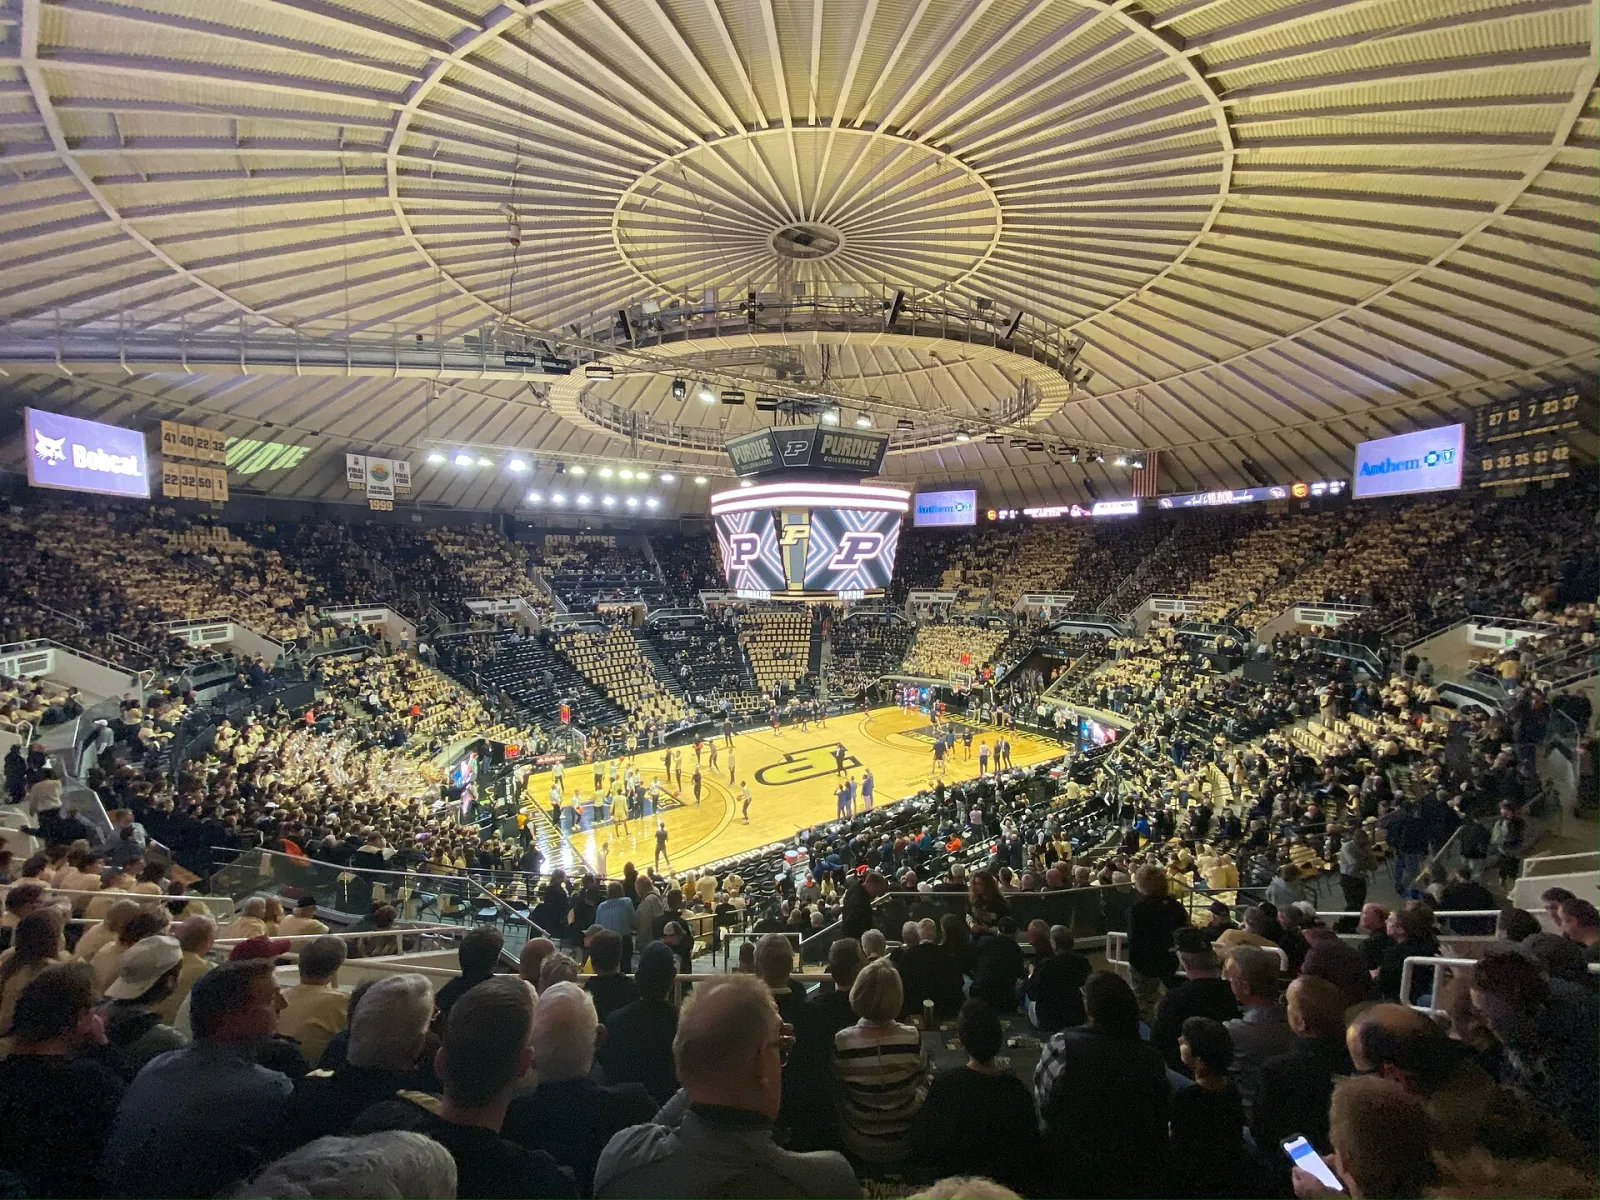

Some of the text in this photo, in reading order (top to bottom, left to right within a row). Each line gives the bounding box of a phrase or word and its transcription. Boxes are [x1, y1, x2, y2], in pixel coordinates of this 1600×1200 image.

[1528, 404, 1536, 417] 7
[164, 432, 225, 452] 41 40 22 32
[732, 438, 773, 464] PURDUE
[783, 440, 809, 457] P
[820, 434, 880, 460] PURDUE
[72, 443, 142, 476] Bobcat
[823, 455, 870, 467] BOILERMAKERS
[1360, 457, 1420, 477] Anthem
[164, 474, 222, 489] 22 32 50 1
[369, 500, 393, 511] 1999
[917, 503, 955, 514] Anthem
[730, 533, 761, 570] P
[828, 532, 884, 570] P
